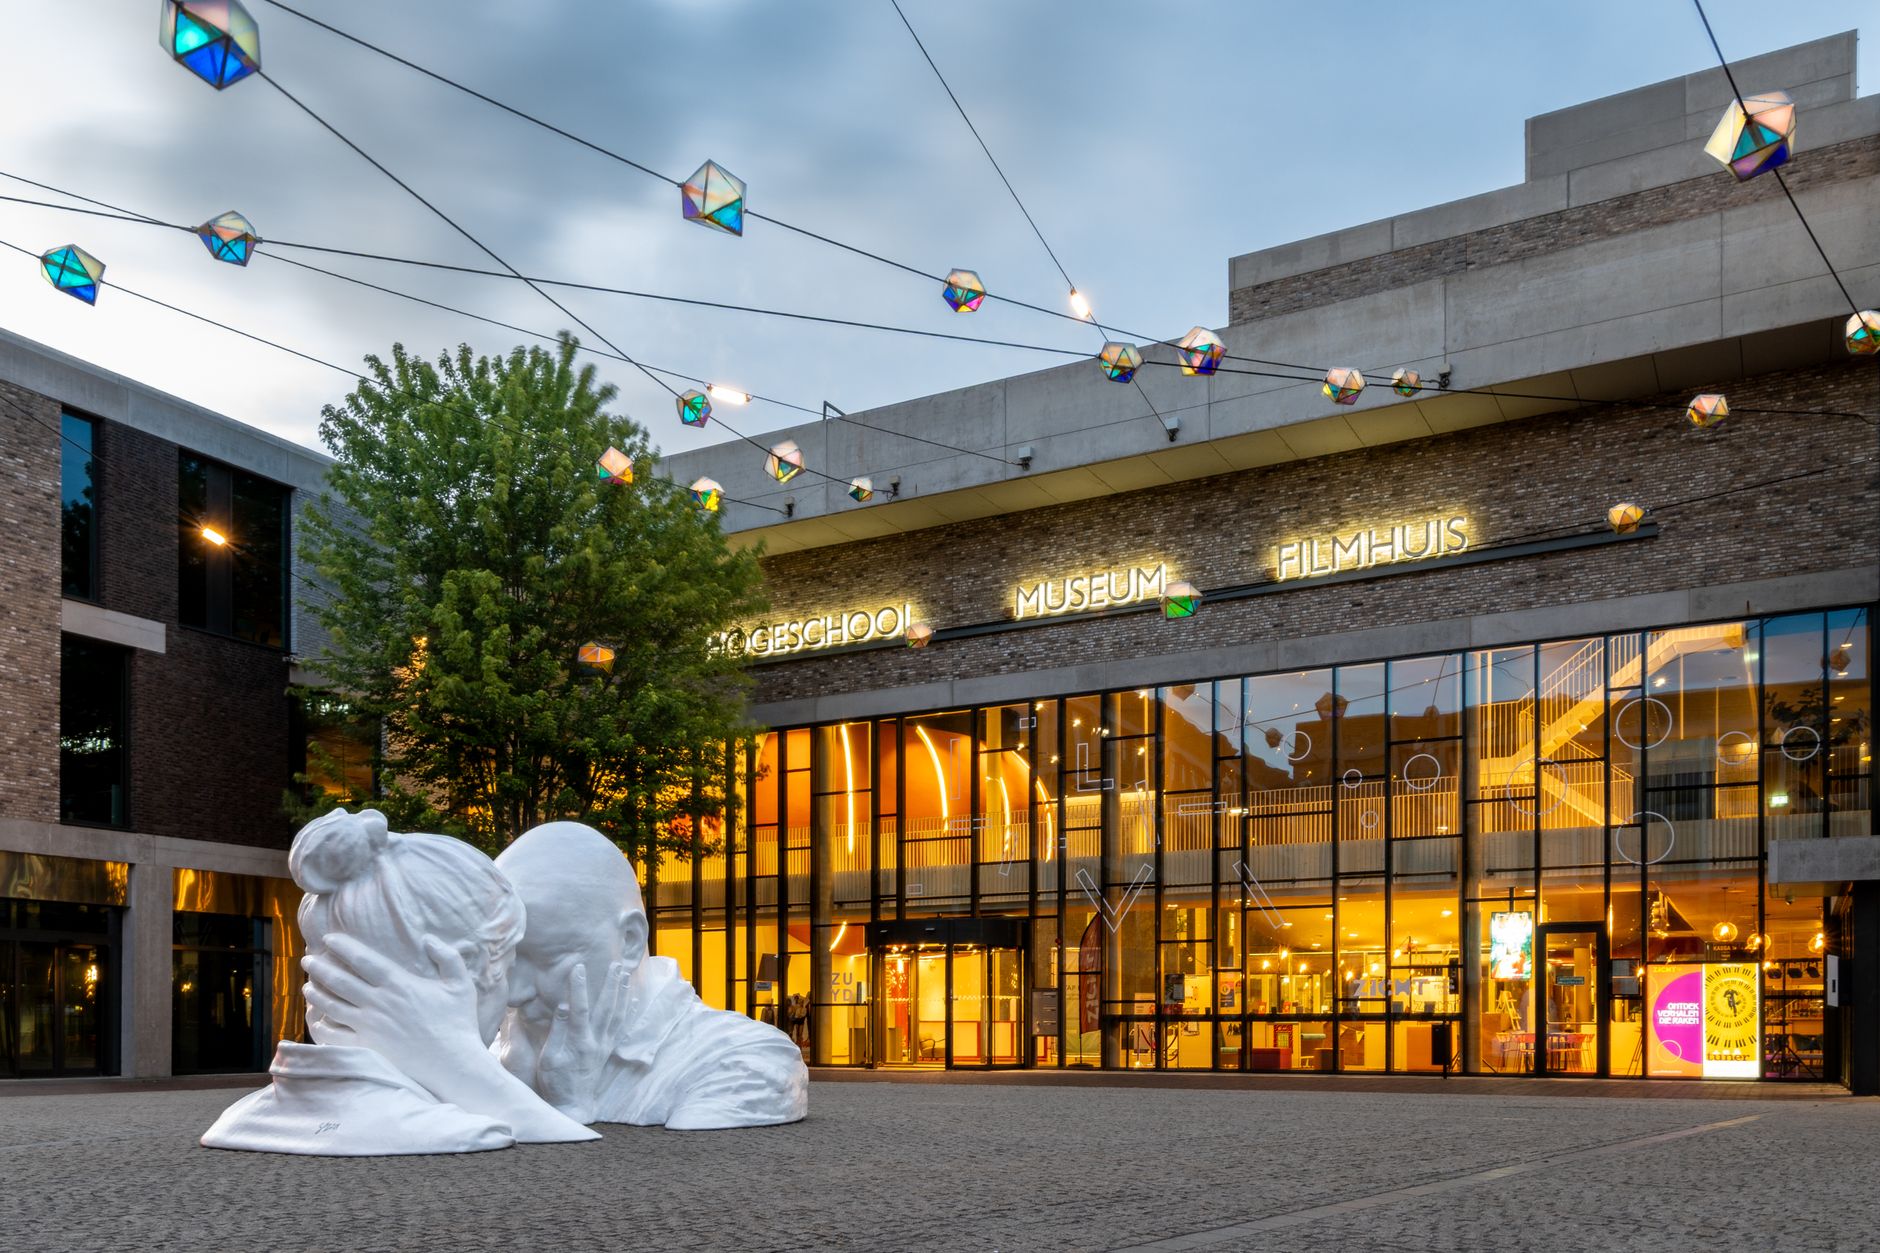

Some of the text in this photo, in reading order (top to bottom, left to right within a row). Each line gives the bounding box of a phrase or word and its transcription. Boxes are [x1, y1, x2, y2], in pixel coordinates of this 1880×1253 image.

[1277, 515, 1468, 580] FILMHUIS
[1016, 561, 1167, 619] MUSEUM
[1707, 1052, 1750, 1061] tuner
